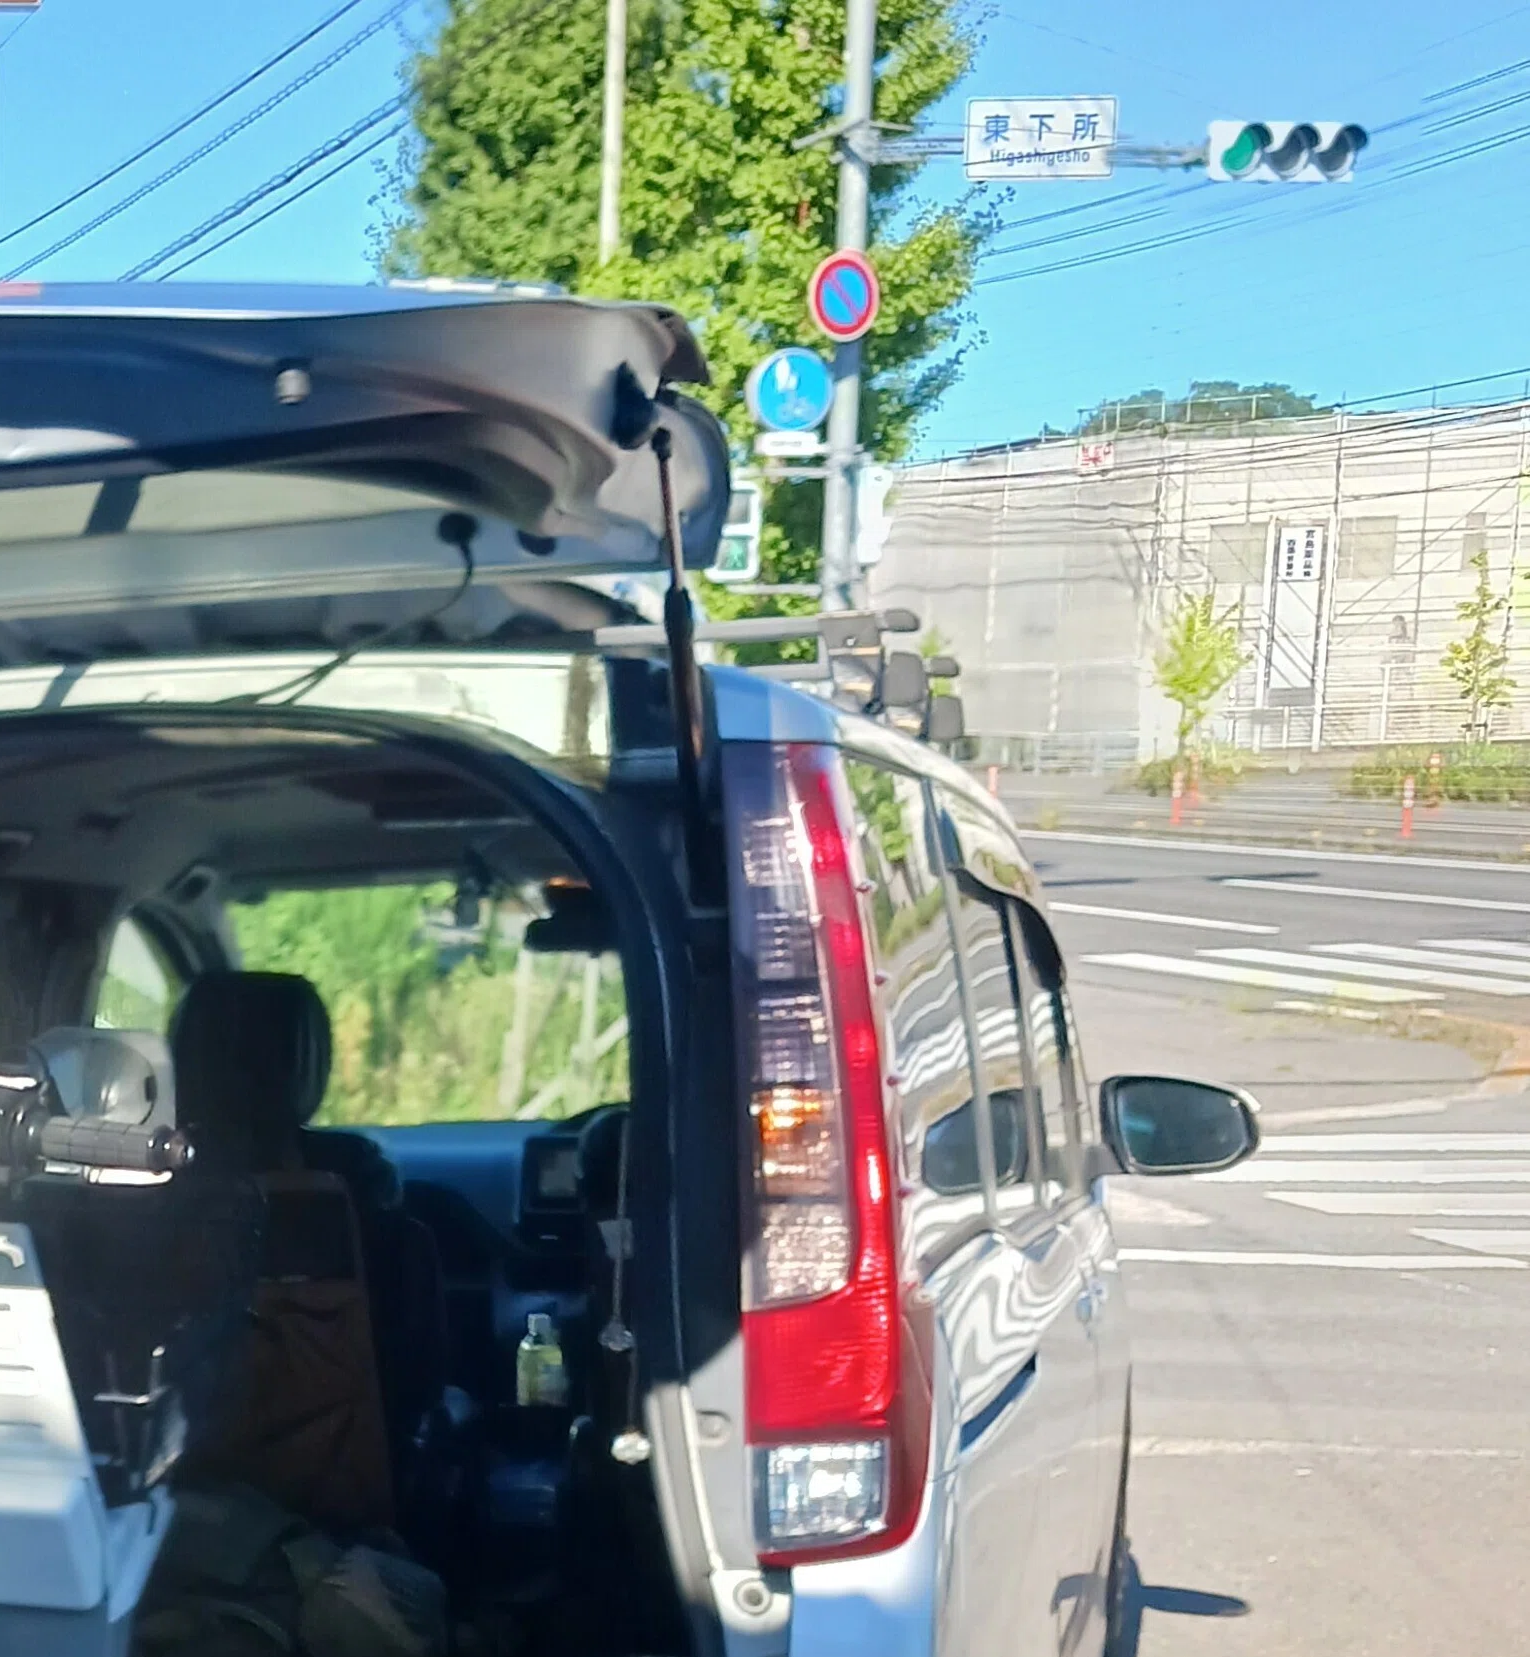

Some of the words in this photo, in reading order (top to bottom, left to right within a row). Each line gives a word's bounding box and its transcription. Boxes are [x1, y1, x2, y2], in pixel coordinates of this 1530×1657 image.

[983, 113, 1101, 142] 東下所
[989, 147, 1091, 167] Higashigesho
